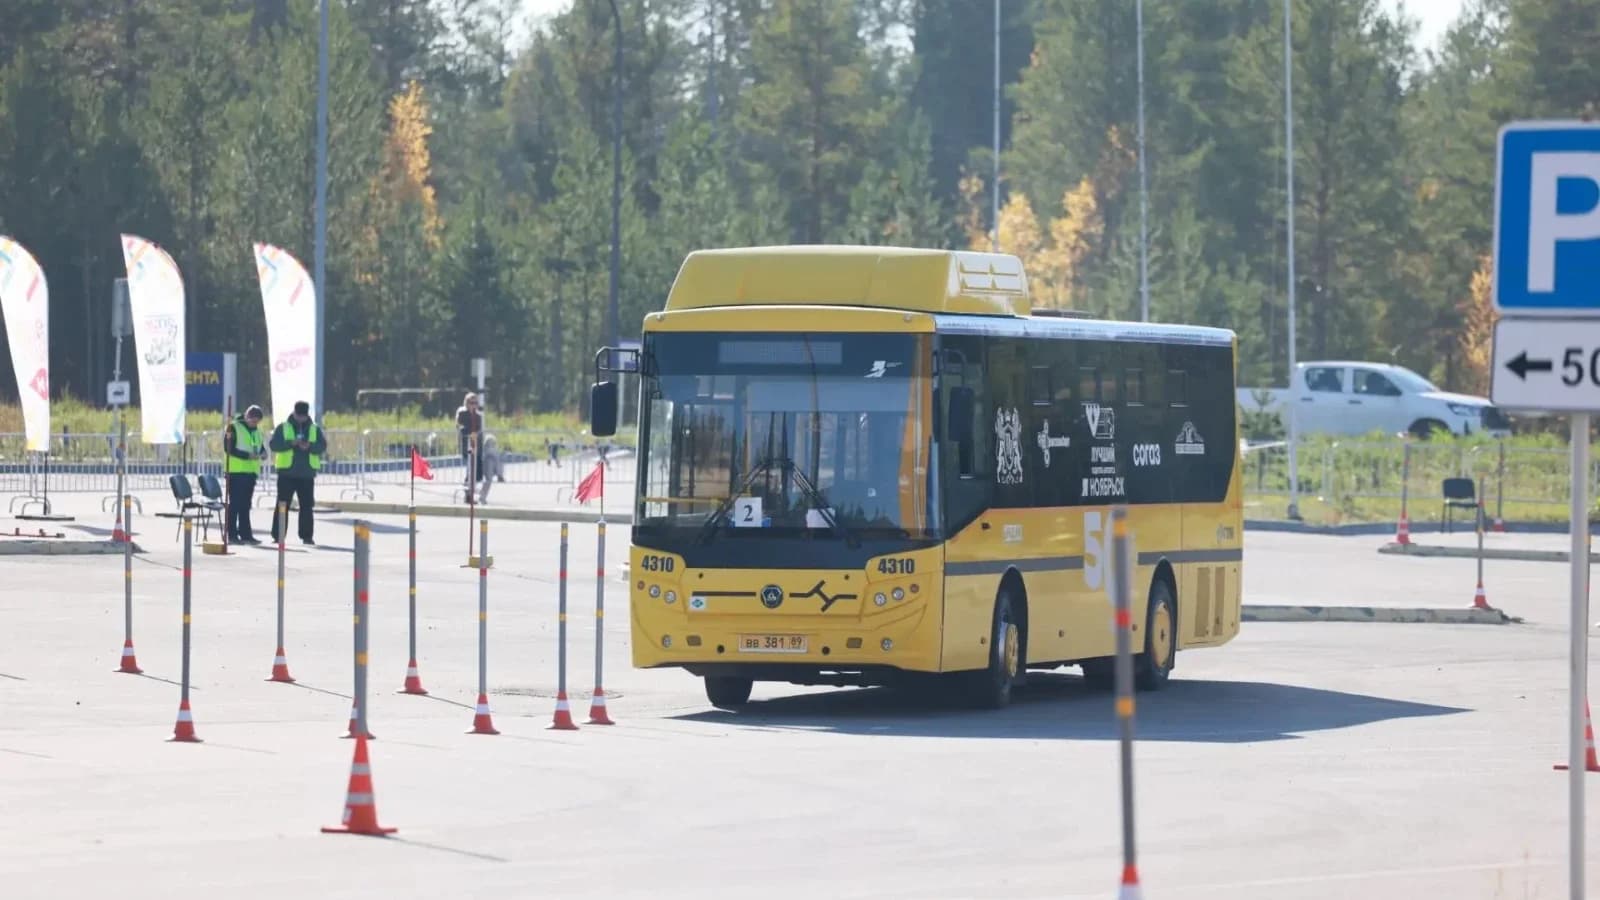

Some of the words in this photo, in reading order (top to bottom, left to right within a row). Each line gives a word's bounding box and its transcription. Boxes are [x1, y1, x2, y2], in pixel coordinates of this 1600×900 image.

[1527, 152, 1600, 293] P
[743, 505, 753, 522] 2
[641, 555, 674, 573] 4310
[878, 558, 915, 574] 4310
